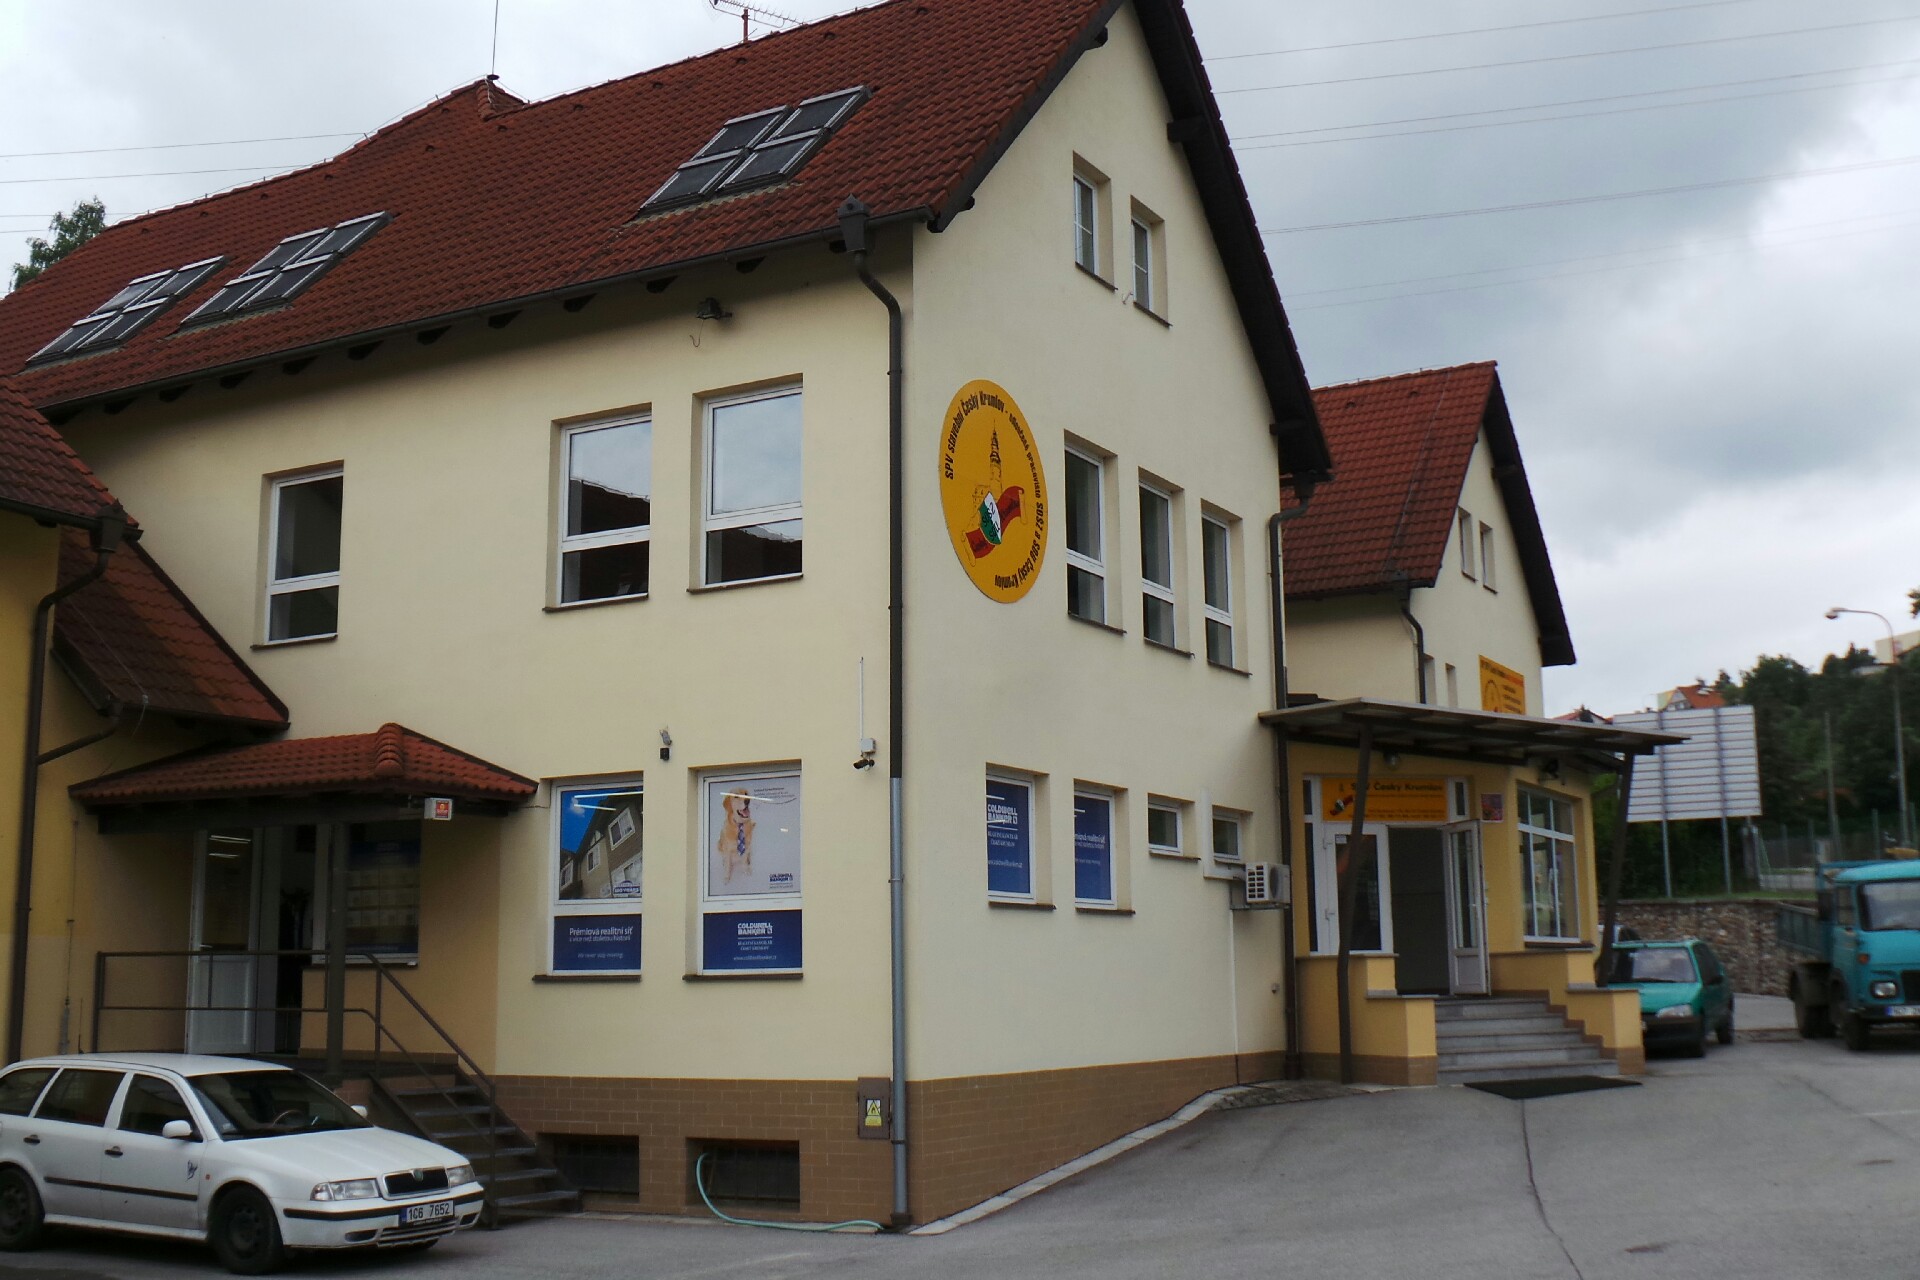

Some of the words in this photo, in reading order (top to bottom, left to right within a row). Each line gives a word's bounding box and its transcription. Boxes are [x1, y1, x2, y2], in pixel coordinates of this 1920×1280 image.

[960, 393, 979, 416] Český
[979, 391, 1005, 413] Krumlov
[947, 406, 965, 454] stavební
[944, 453, 954, 480] SPV
[1017, 557, 1035, 585] Český
[994, 573, 1019, 591] Krumlov
[1373, 781, 1401, 792] Český
[1405, 783, 1443, 791] Krumlov
[988, 804, 1018, 816] COLDWELL
[569, 927, 600, 936] Prémiová
[600, 926, 624, 935] realitní
[408, 1207, 424, 1220] 1C6
[429, 1202, 450, 1218] 7652
